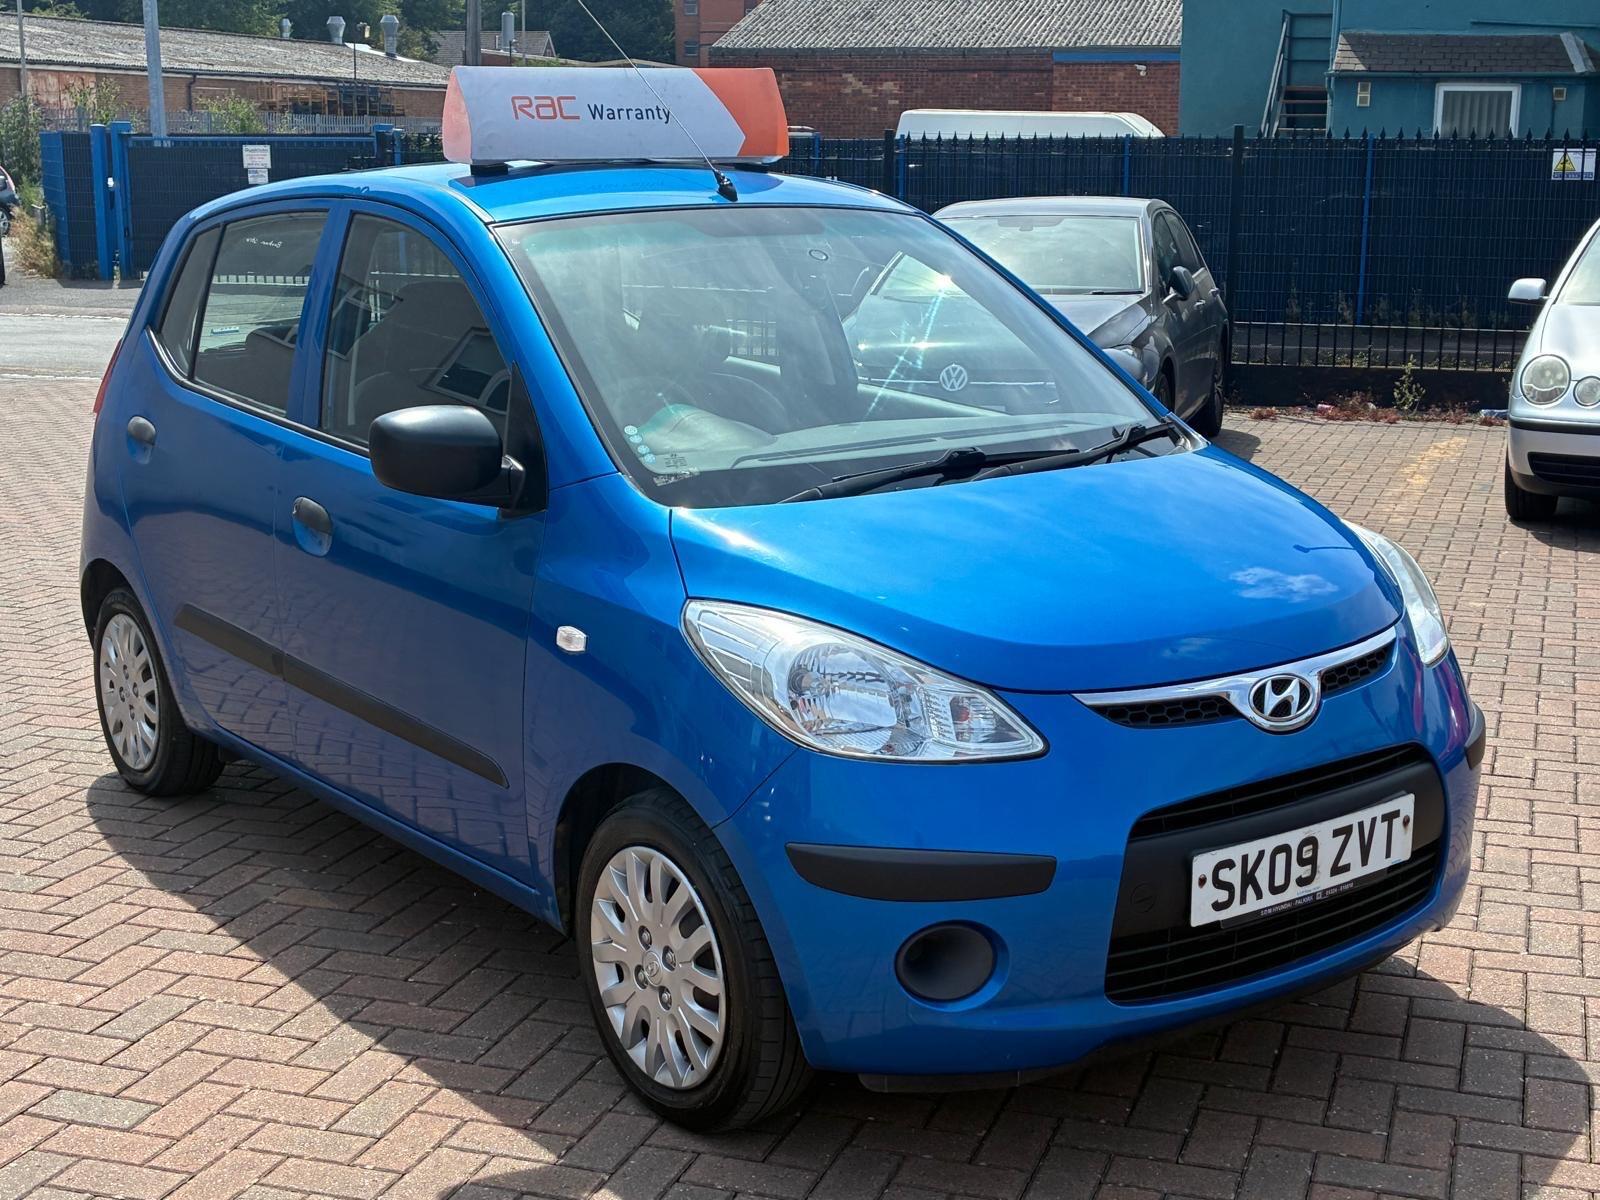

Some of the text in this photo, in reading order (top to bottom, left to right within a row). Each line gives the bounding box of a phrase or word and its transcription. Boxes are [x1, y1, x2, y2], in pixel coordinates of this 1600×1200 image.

[587, 103, 671, 124] Warranty
[1211, 809, 1400, 912] SK09 ZVT
